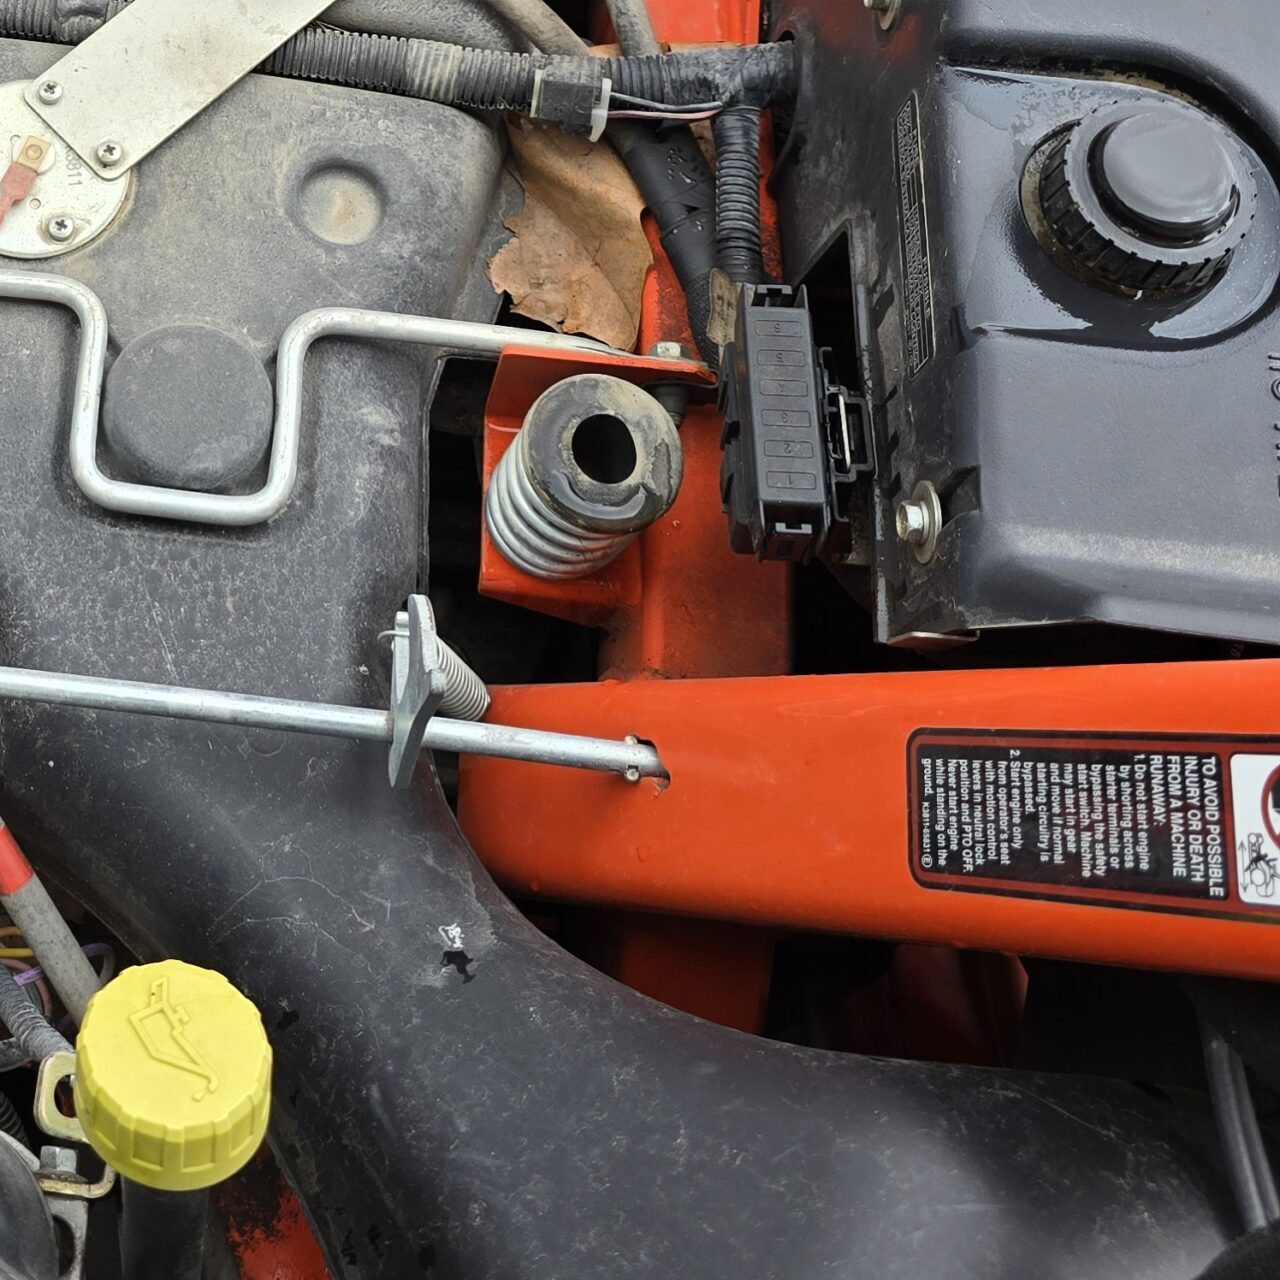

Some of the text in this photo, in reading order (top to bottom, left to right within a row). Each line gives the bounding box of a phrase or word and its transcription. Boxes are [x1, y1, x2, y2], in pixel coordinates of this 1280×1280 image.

[1010, 760, 1022, 786] Start
[1134, 764, 1146, 779] Do
[1135, 782, 1147, 800] not
[1149, 754, 1166, 825] RUNAWAY:
[1009, 788, 1022, 824] engine
[1105, 764, 1120, 868] starter terminals or
[1118, 765, 1134, 868] by shorting across
[1136, 803, 1148, 829] start
[1166, 755, 1186, 876] FROM A MACHINE
[1183, 755, 1204, 881] INJURY OR DEATH
[1201, 756, 1224, 896] TO AVOID POSSIBLE
[1010, 826, 1023, 848] only
[1136, 830, 1150, 870] engine
